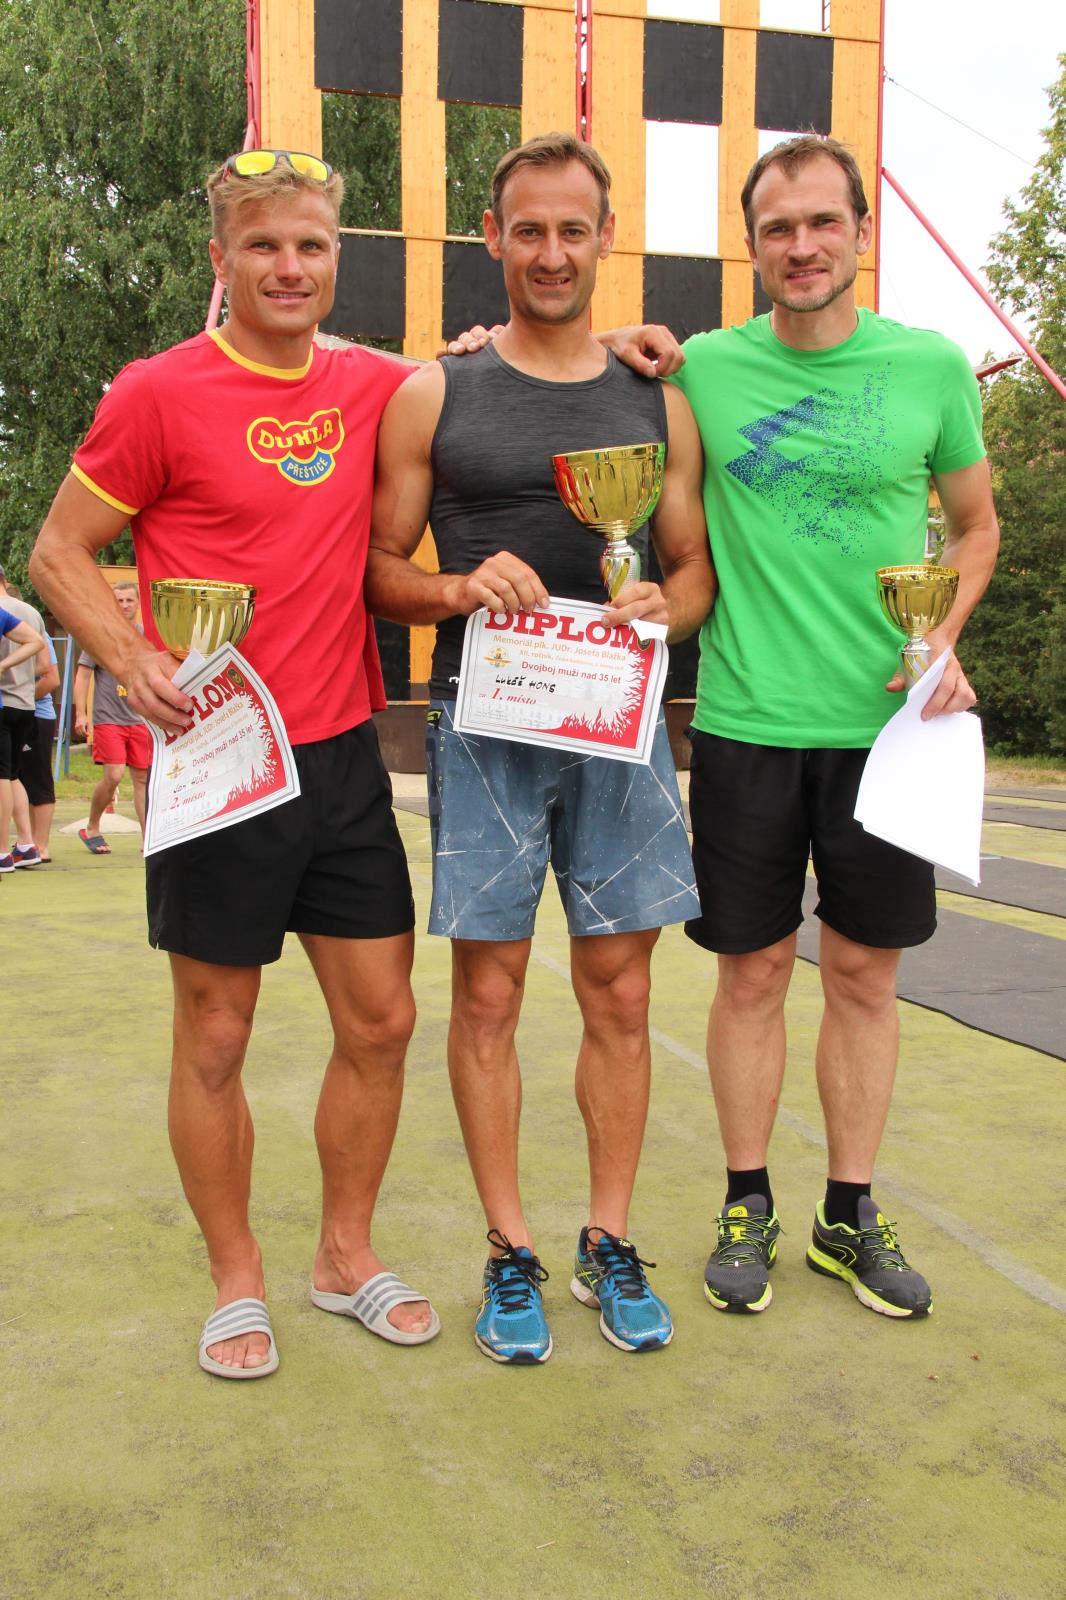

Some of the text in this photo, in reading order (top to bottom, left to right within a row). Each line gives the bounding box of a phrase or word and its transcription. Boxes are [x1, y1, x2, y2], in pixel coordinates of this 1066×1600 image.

[258, 419, 333, 449] DUHLA
[484, 607, 637, 649] DIPLOM
[493, 634, 533, 647] Memoriál
[575, 646, 600, 657] Josefa
[521, 661, 556, 675] Dvojboj
[558, 667, 579, 677] muži
[581, 671, 597, 680] nad
[598, 673, 609, 682] 35
[610, 675, 622, 684] let
[506, 694, 537, 705] místo
[229, 734, 240, 745] nad
